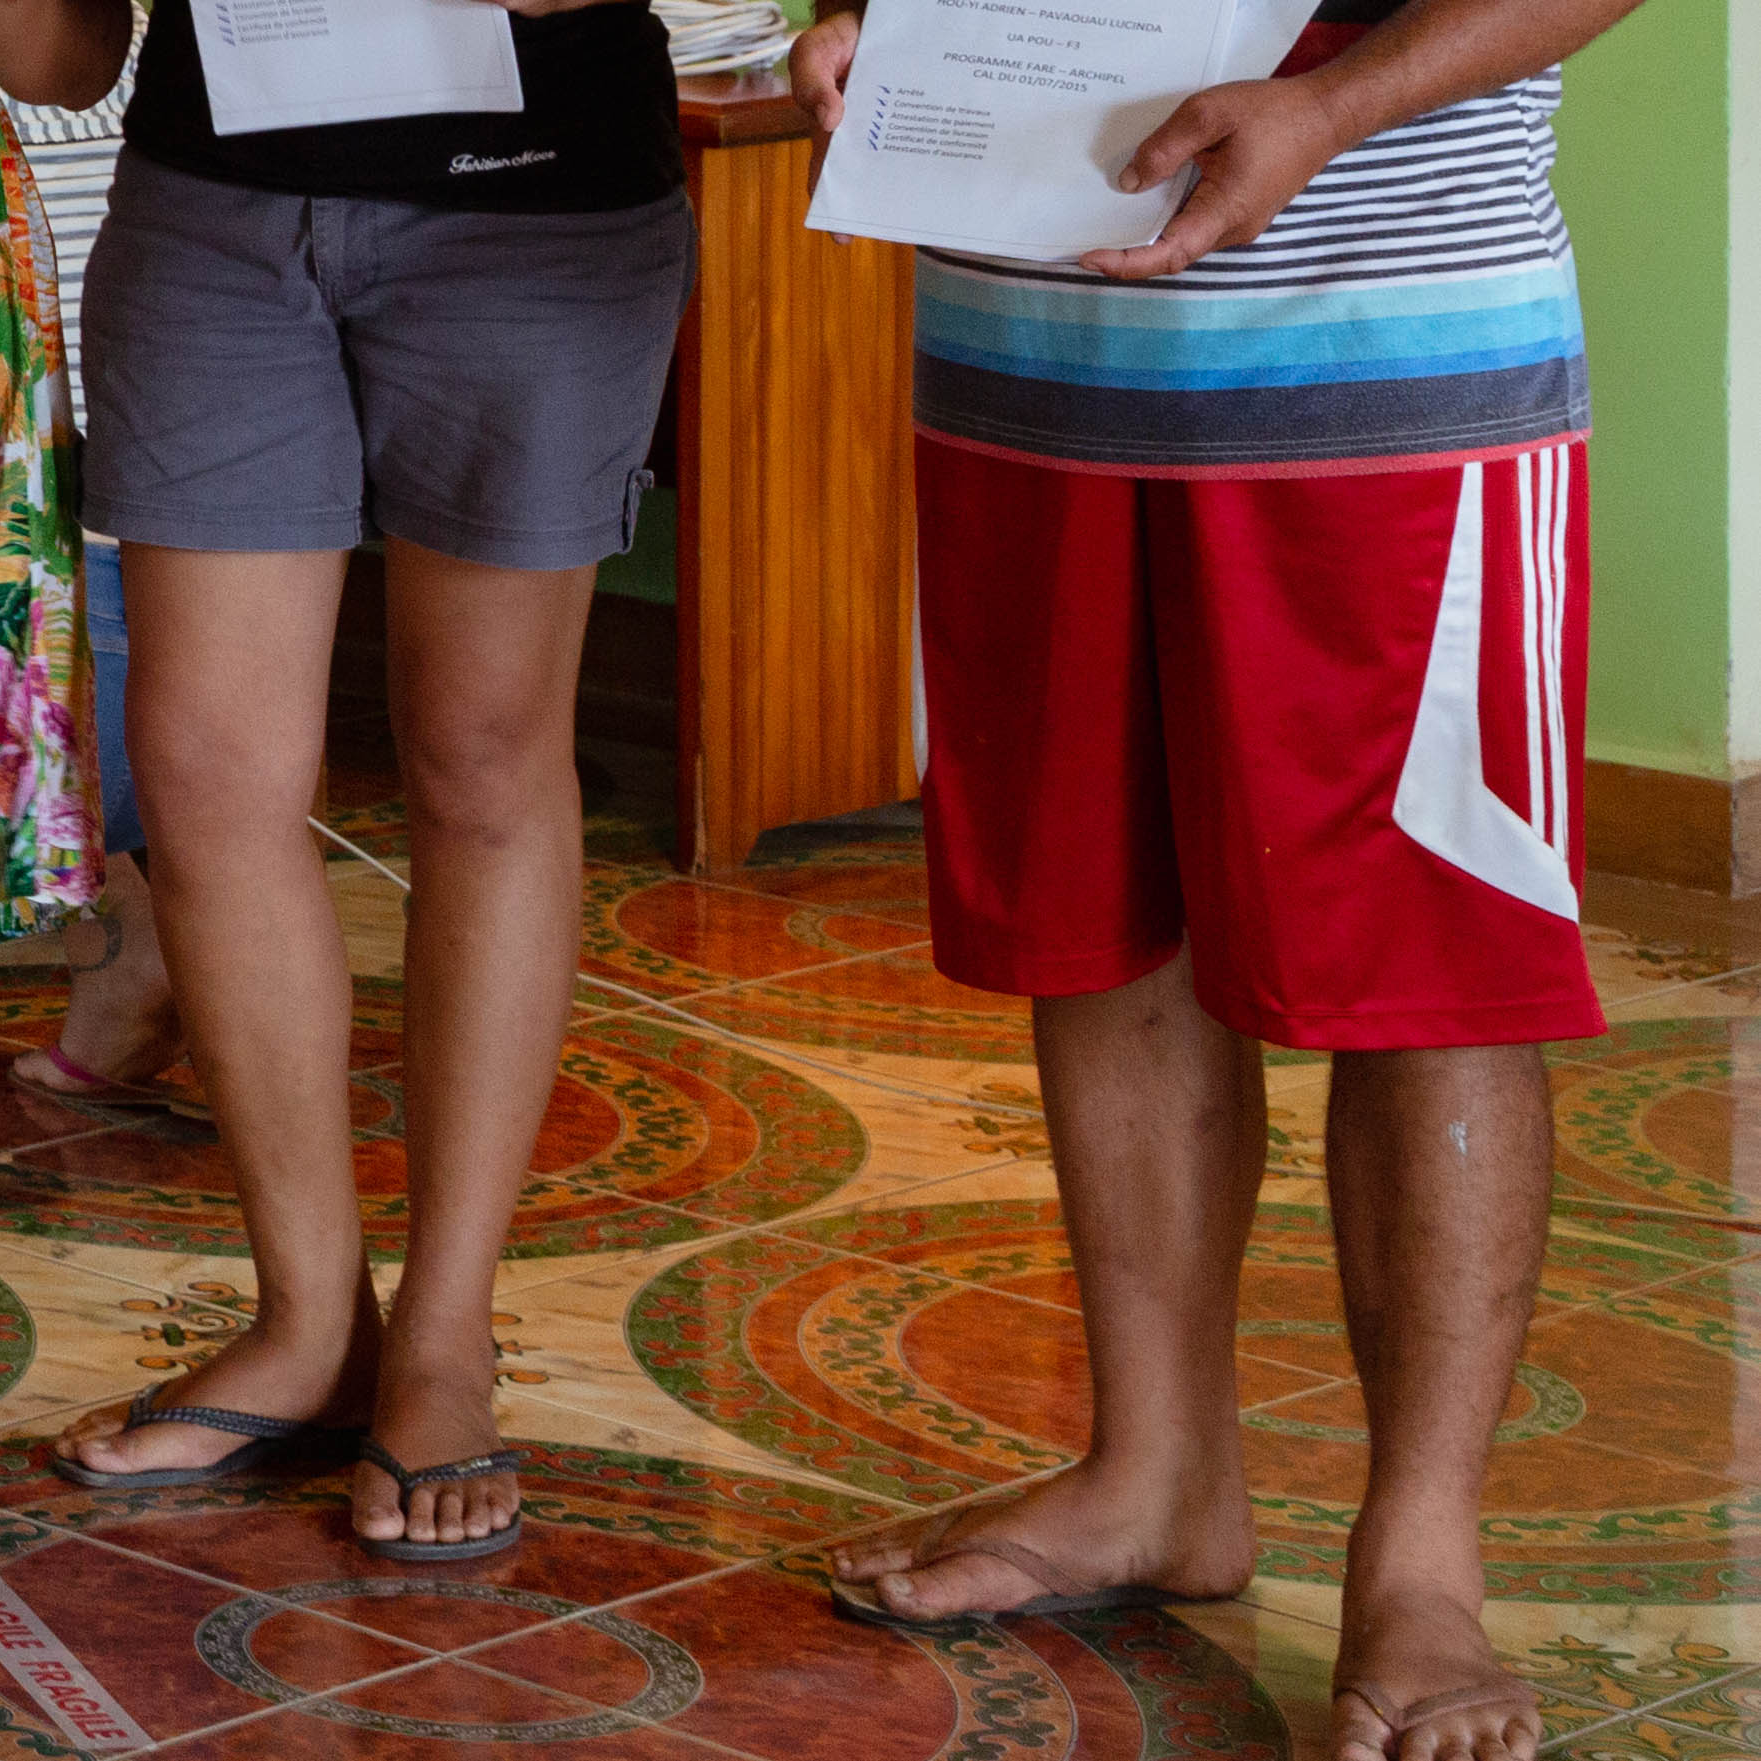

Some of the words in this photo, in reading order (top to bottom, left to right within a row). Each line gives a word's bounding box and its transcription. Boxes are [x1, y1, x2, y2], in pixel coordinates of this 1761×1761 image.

[981, 1, 1027, 17] ADRIEN
[1039, 9, 1106, 27] PAVAOUAU
[1109, 19, 1163, 34] LUCINDA
[1007, 32, 1025, 43] UA
[1027, 34, 1054, 47] POU
[943, 52, 1023, 71] PROGRAMME
[1026, 62, 1056, 74] FARE
[1069, 69, 1126, 85] ARCHIPEL
[973, 69, 995, 81] CAL
[997, 71, 1016, 83] DU
[1018, 75, 1088, 92] 01/07/2015
[20, 1659, 127, 1742] FRAGILE
